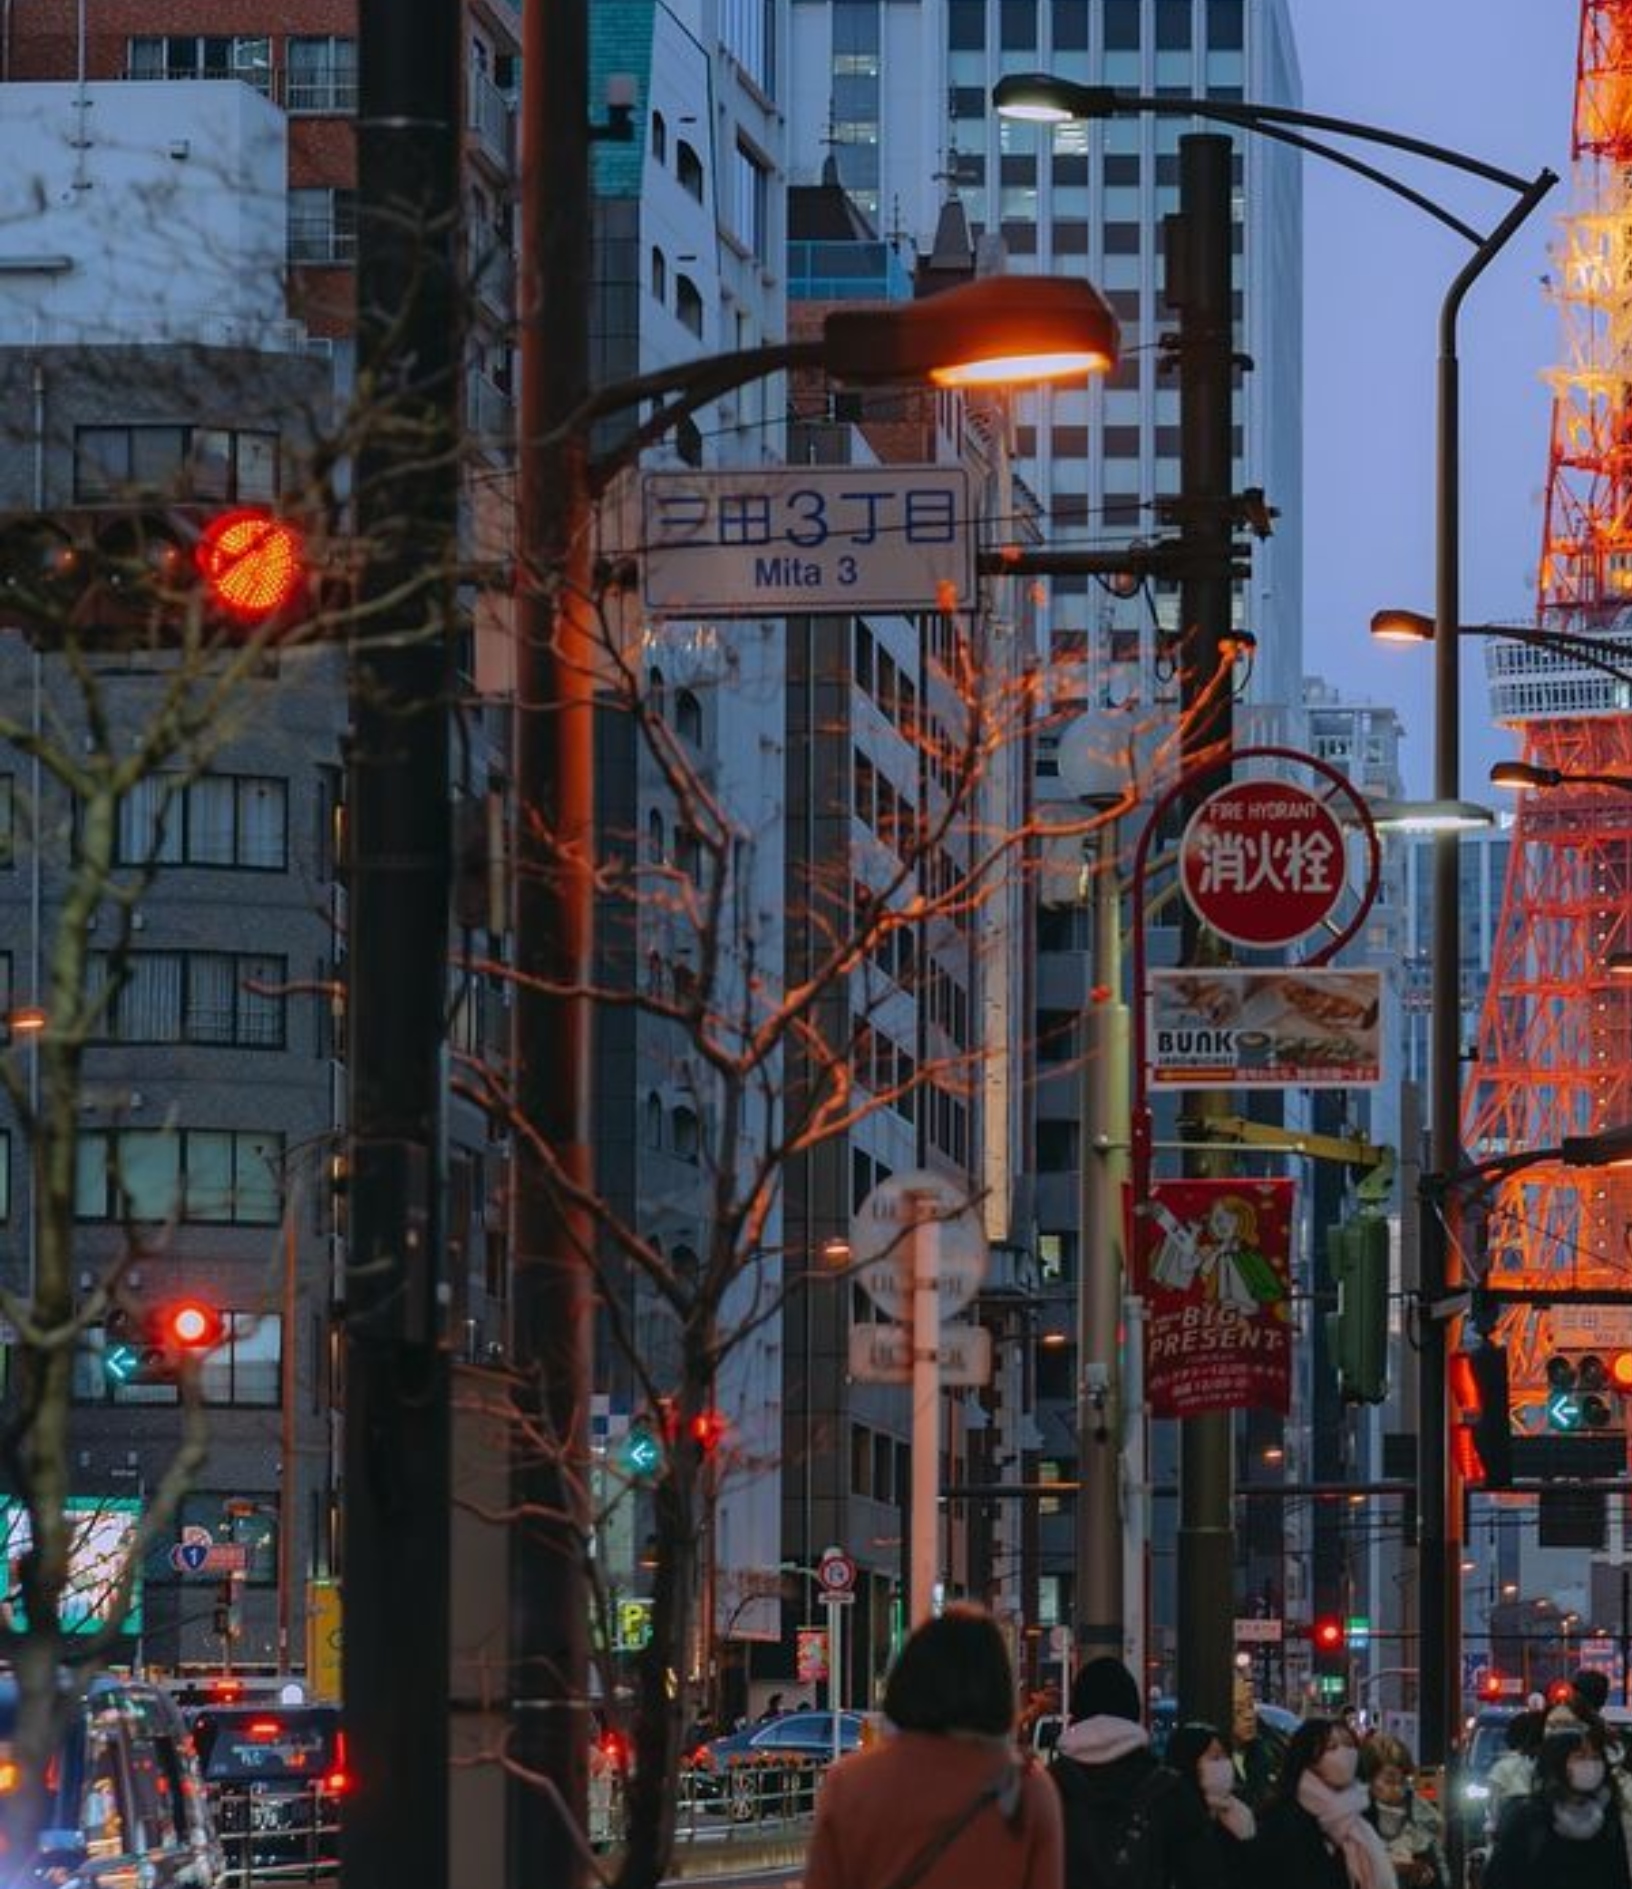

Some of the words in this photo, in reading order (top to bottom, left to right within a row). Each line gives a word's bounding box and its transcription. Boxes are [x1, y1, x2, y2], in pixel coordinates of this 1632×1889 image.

[656, 489, 955, 547] 三田3丁目
[756, 557, 822, 587] Mita
[838, 556, 858, 586] 3
[1210, 802, 1243, 821] FIRE
[1248, 801, 1318, 821] HYDRANT
[1199, 830, 1334, 894] 消火栓
[1158, 1031, 1231, 1054] BUNK
[1183, 1303, 1237, 1327] BIG
[1150, 1326, 1283, 1362] PRESENT
[624, 1604, 643, 1631] P
